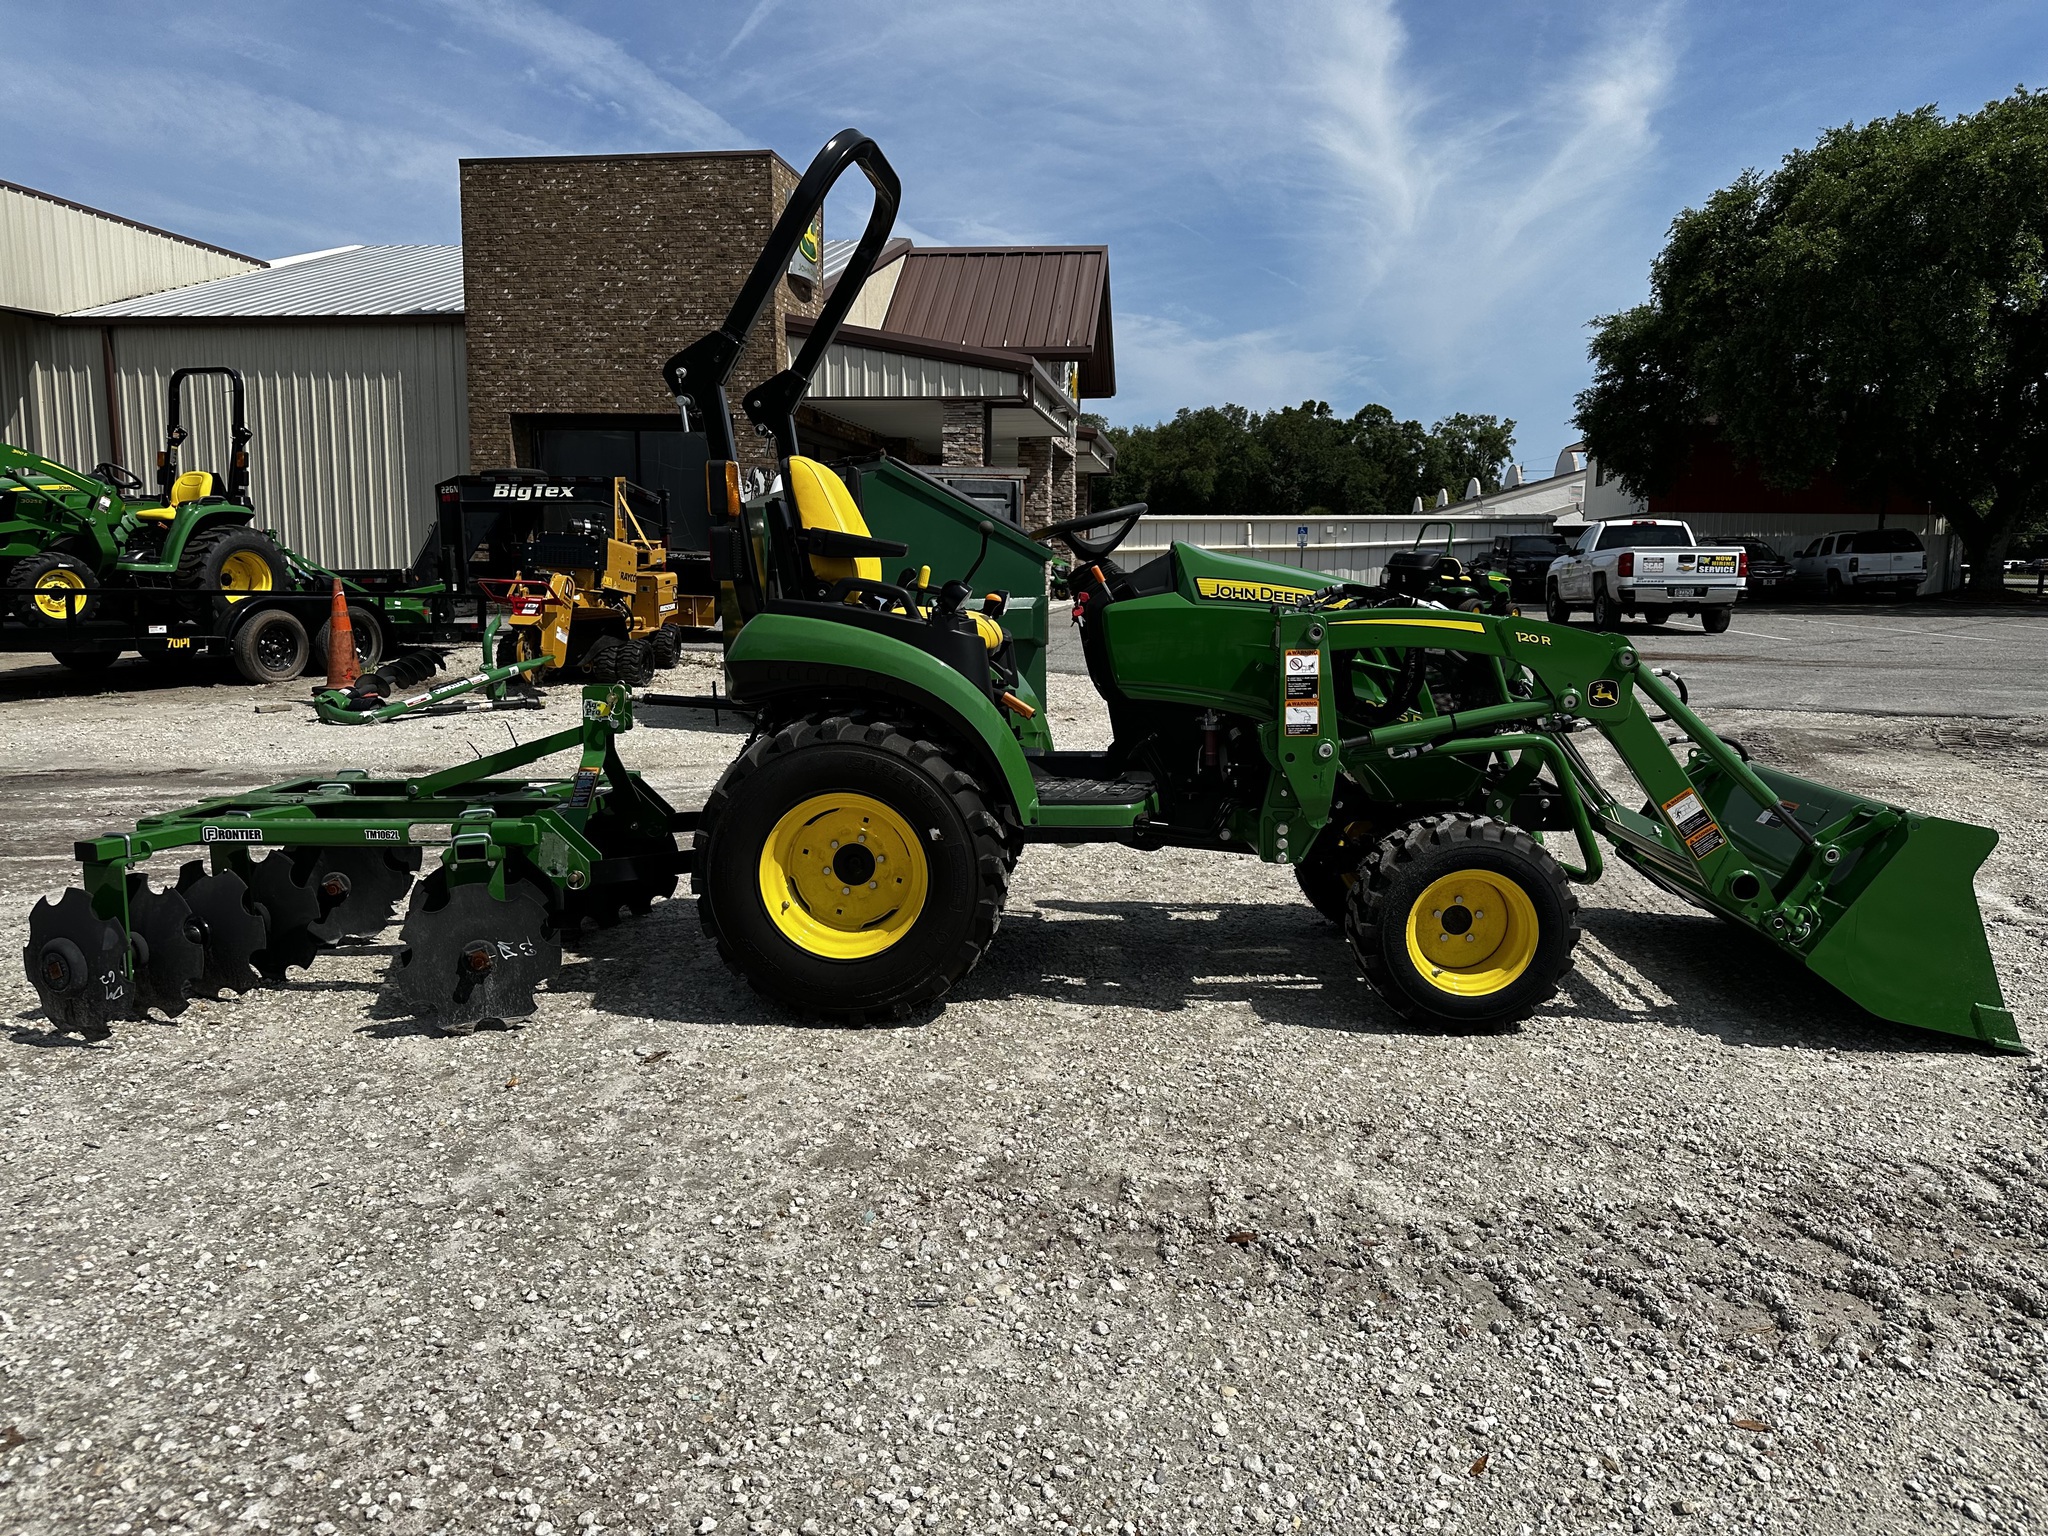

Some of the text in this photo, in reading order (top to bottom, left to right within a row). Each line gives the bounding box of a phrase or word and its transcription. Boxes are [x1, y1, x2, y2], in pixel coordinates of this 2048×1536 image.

[493, 483, 575, 501] BigTex
[1210, 584, 1310, 604] JOHN DEER
[203, 826, 263, 842] FRONTIER
